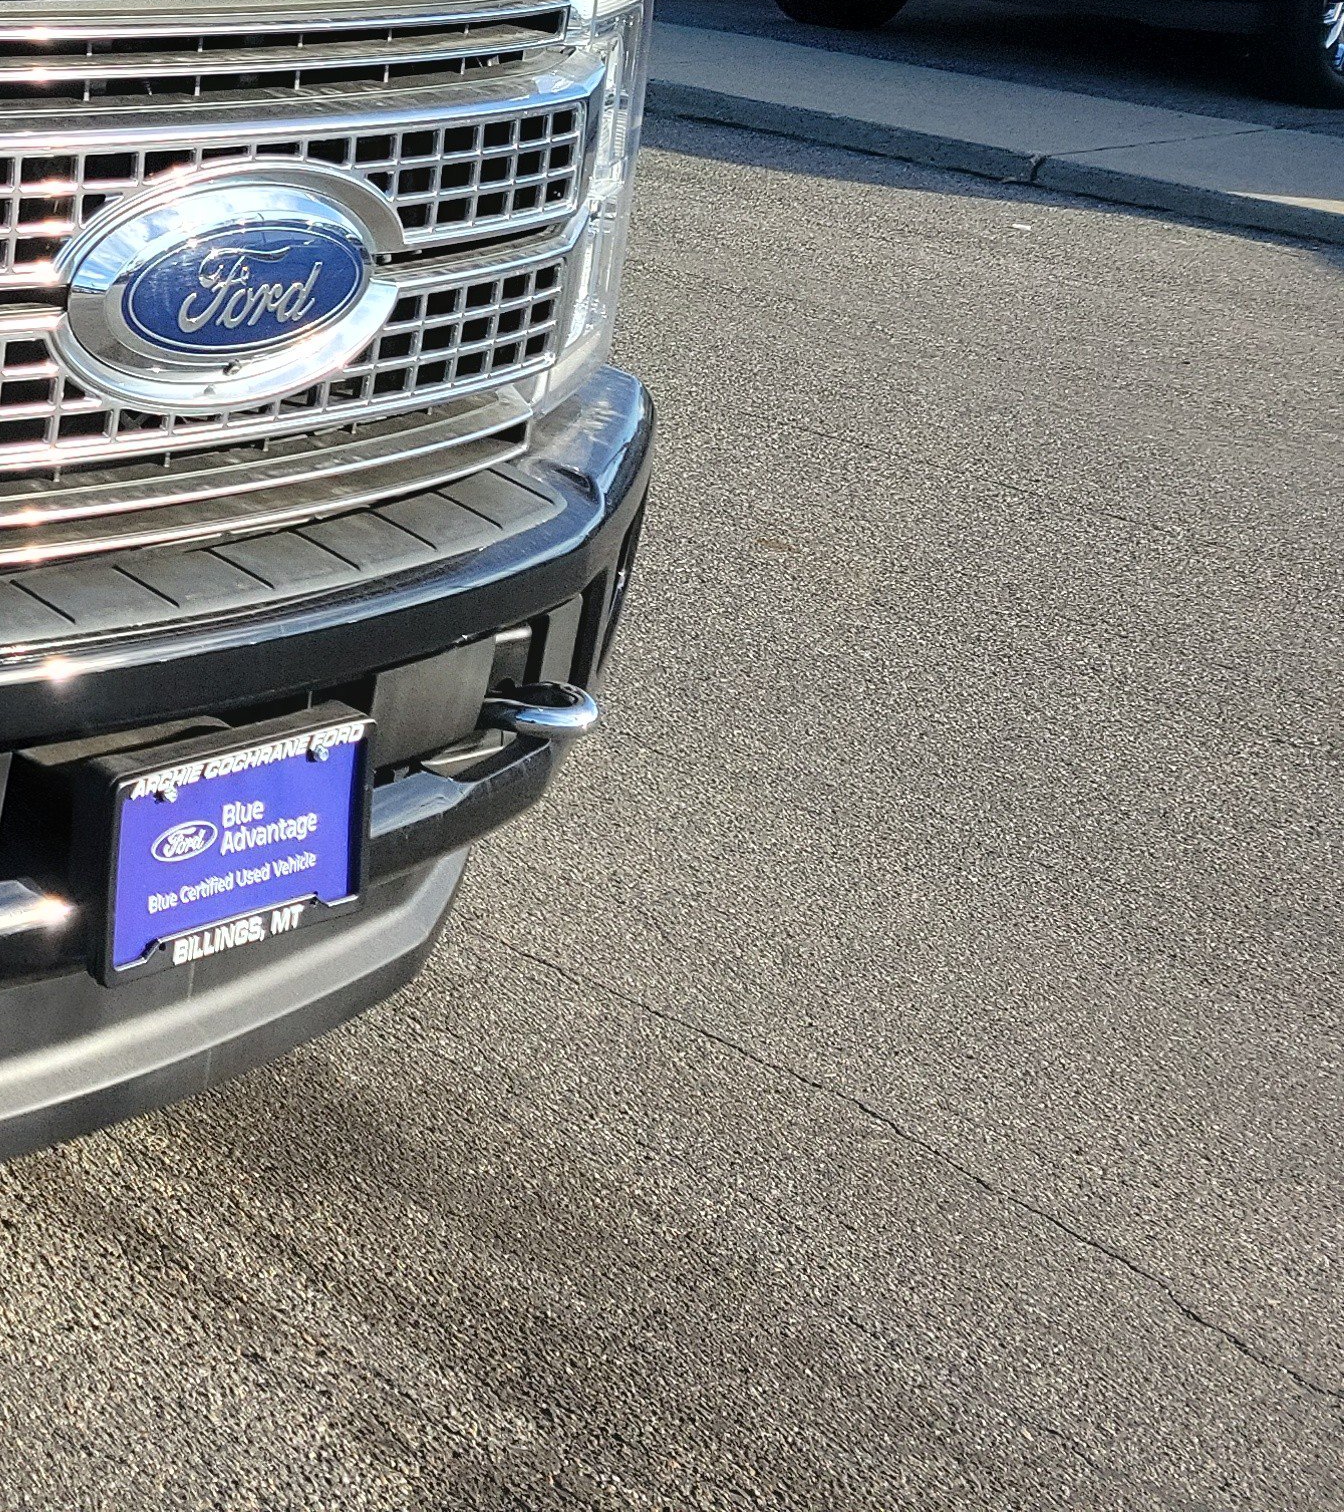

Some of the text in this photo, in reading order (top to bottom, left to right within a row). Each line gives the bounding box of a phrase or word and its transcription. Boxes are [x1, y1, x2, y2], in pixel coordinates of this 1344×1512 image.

[178, 246, 323, 334] Ford
[130, 723, 365, 801] ARCHIE COCHRANE FORD
[162, 826, 206, 858] Ford
[220, 812, 318, 856] Advantage
[222, 801, 265, 829] Blue
[148, 851, 318, 914] Blue Certified Used Vehicle
[172, 903, 306, 966] BILLINGS, MT
